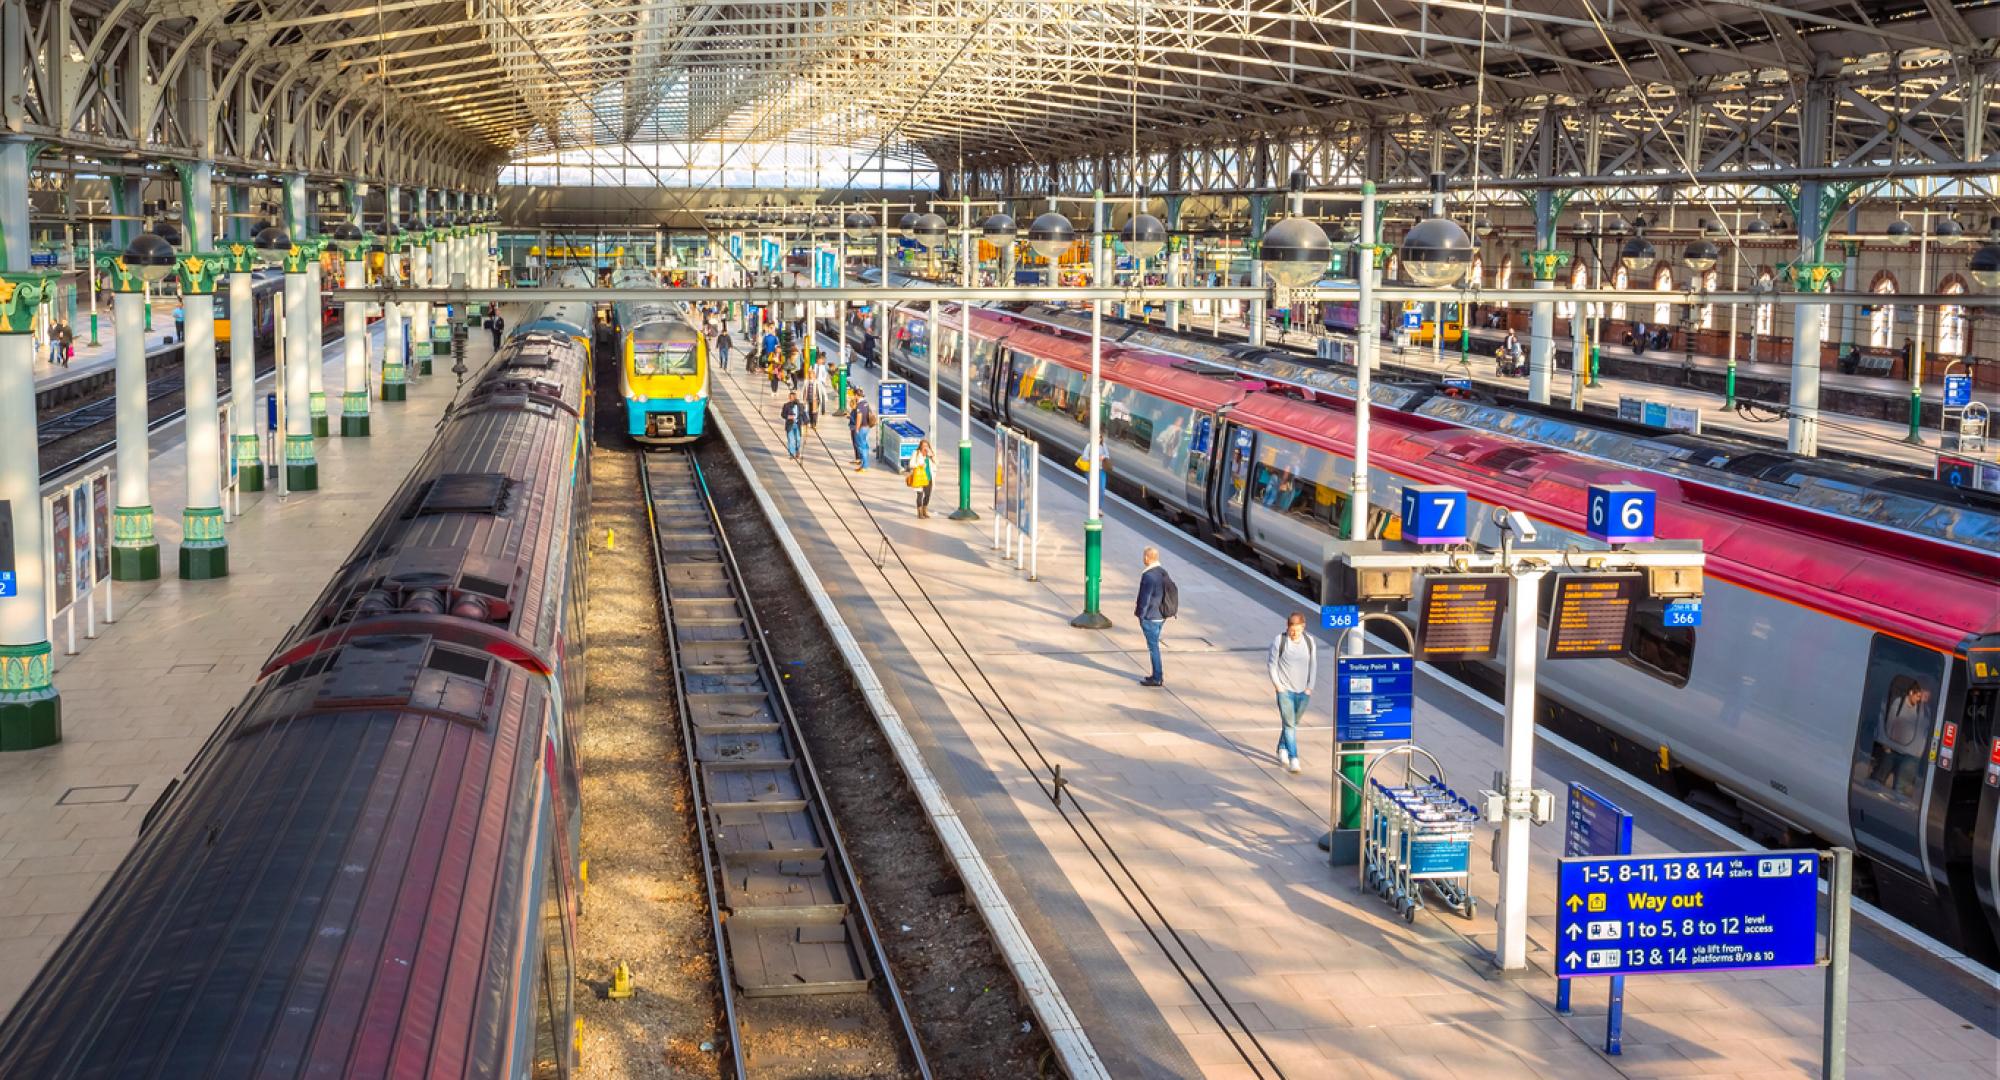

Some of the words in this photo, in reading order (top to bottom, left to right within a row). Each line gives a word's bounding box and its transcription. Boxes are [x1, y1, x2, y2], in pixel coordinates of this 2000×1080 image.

[1406, 495, 1415, 526] 7
[1433, 498, 1456, 530] 7
[1592, 496, 1604, 526] 6
[1621, 498, 1644, 529] 6
[1329, 615, 1352, 627] 368
[1672, 612, 1695, 624] 366
[1349, 663, 1370, 672] Trolley
[1370, 663, 1387, 671] Point
[1947, 725, 1954, 737] E
[1730, 859, 1743, 868] via
[1582, 865, 1614, 884] 1-5,
[1664, 862, 1682, 880] 13
[1686, 862, 1700, 879] &
[1705, 861, 1724, 879] 14
[1729, 868, 1753, 878] stairs
[1628, 892, 1668, 913] Way
[1671, 891, 1704, 908] out
[1744, 915, 1765, 924] level
[1627, 921, 1635, 938] 1
[1639, 922, 1657, 937] to
[1661, 920, 1677, 938] 5,
[1682, 919, 1695, 936] 8
[1698, 919, 1717, 935] to
[1721, 917, 1740, 934] 12
[1744, 925, 1774, 933] access
[1693, 947, 1706, 955] via
[1708, 945, 1721, 953] lift
[1722, 943, 1743, 953] from
[1626, 949, 1645, 966] 13
[1649, 948, 1663, 965] &
[1668, 947, 1687, 964] 14
[1691, 953, 1734, 965] platforms
[1735, 952, 1752, 963] 8/9
[1754, 952, 1761, 961] &
[1764, 950, 1774, 961] 10
